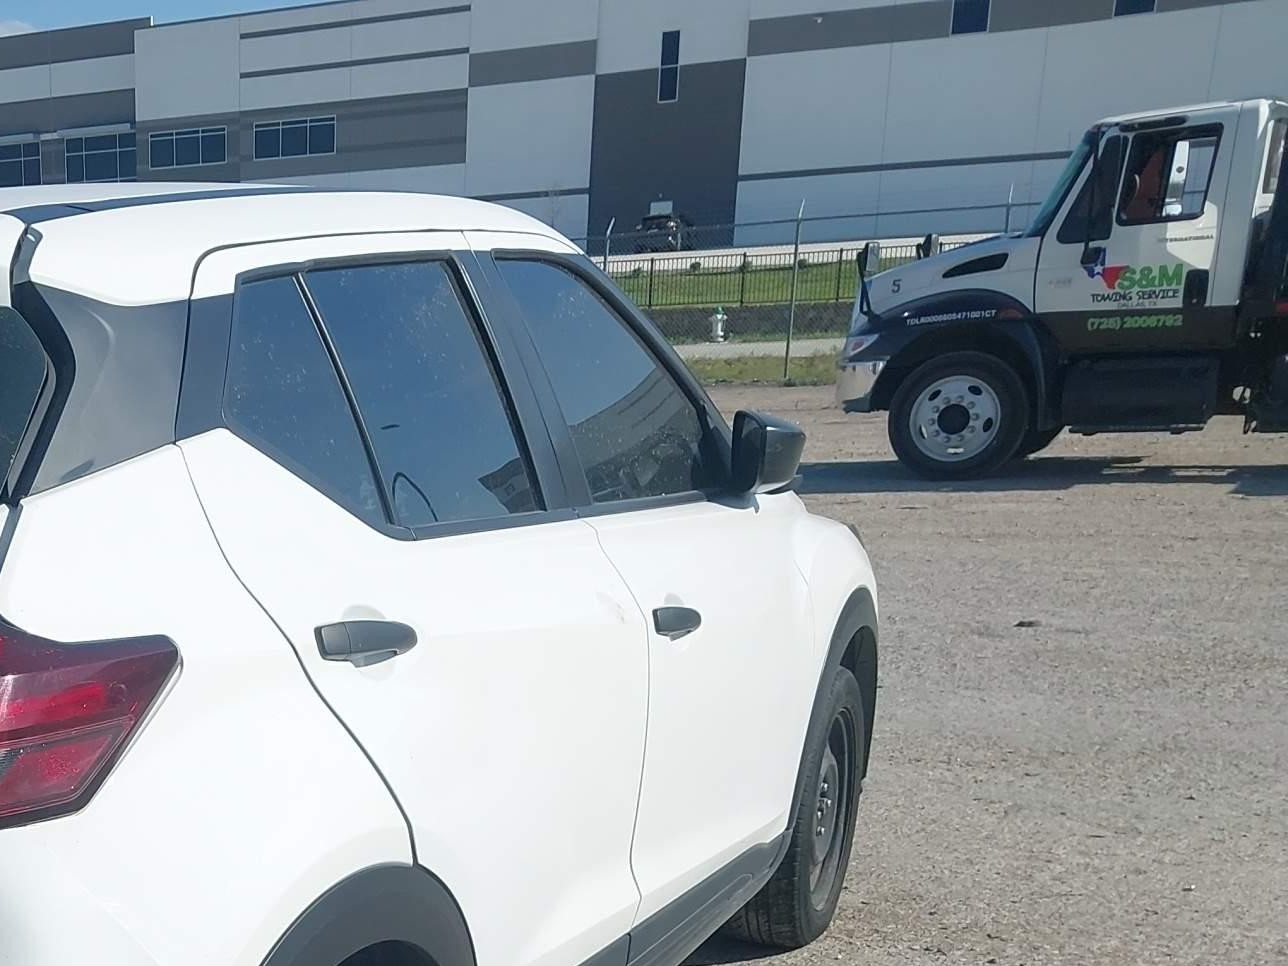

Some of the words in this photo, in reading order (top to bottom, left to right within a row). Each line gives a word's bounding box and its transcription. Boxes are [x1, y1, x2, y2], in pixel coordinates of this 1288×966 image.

[1117, 263, 1183, 290] S&M
[891, 278, 902, 293] 5
[1091, 290, 1132, 303] TOWING
[1136, 288, 1180, 300] SERVICE
